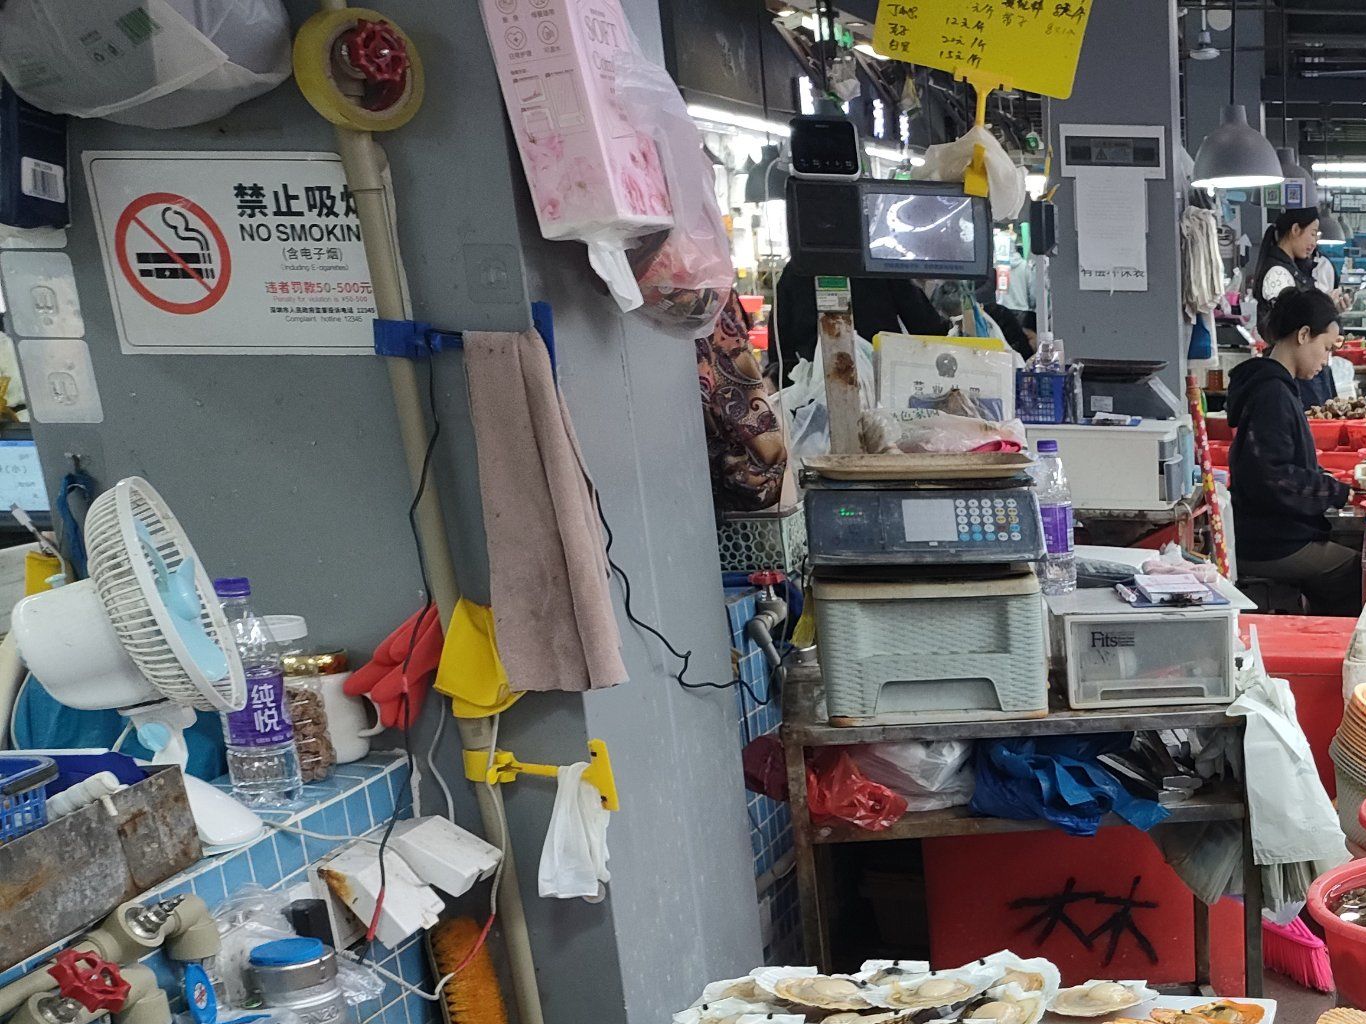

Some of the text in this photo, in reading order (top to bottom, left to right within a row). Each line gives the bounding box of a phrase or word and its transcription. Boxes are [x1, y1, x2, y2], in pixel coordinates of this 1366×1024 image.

[239, 223, 362, 242] NO SMOKIN
[265, 281, 373, 294] 违者罚款50-500元
[1091, 631, 1118, 648] Fits
[251, 683, 282, 733] 纯悦
